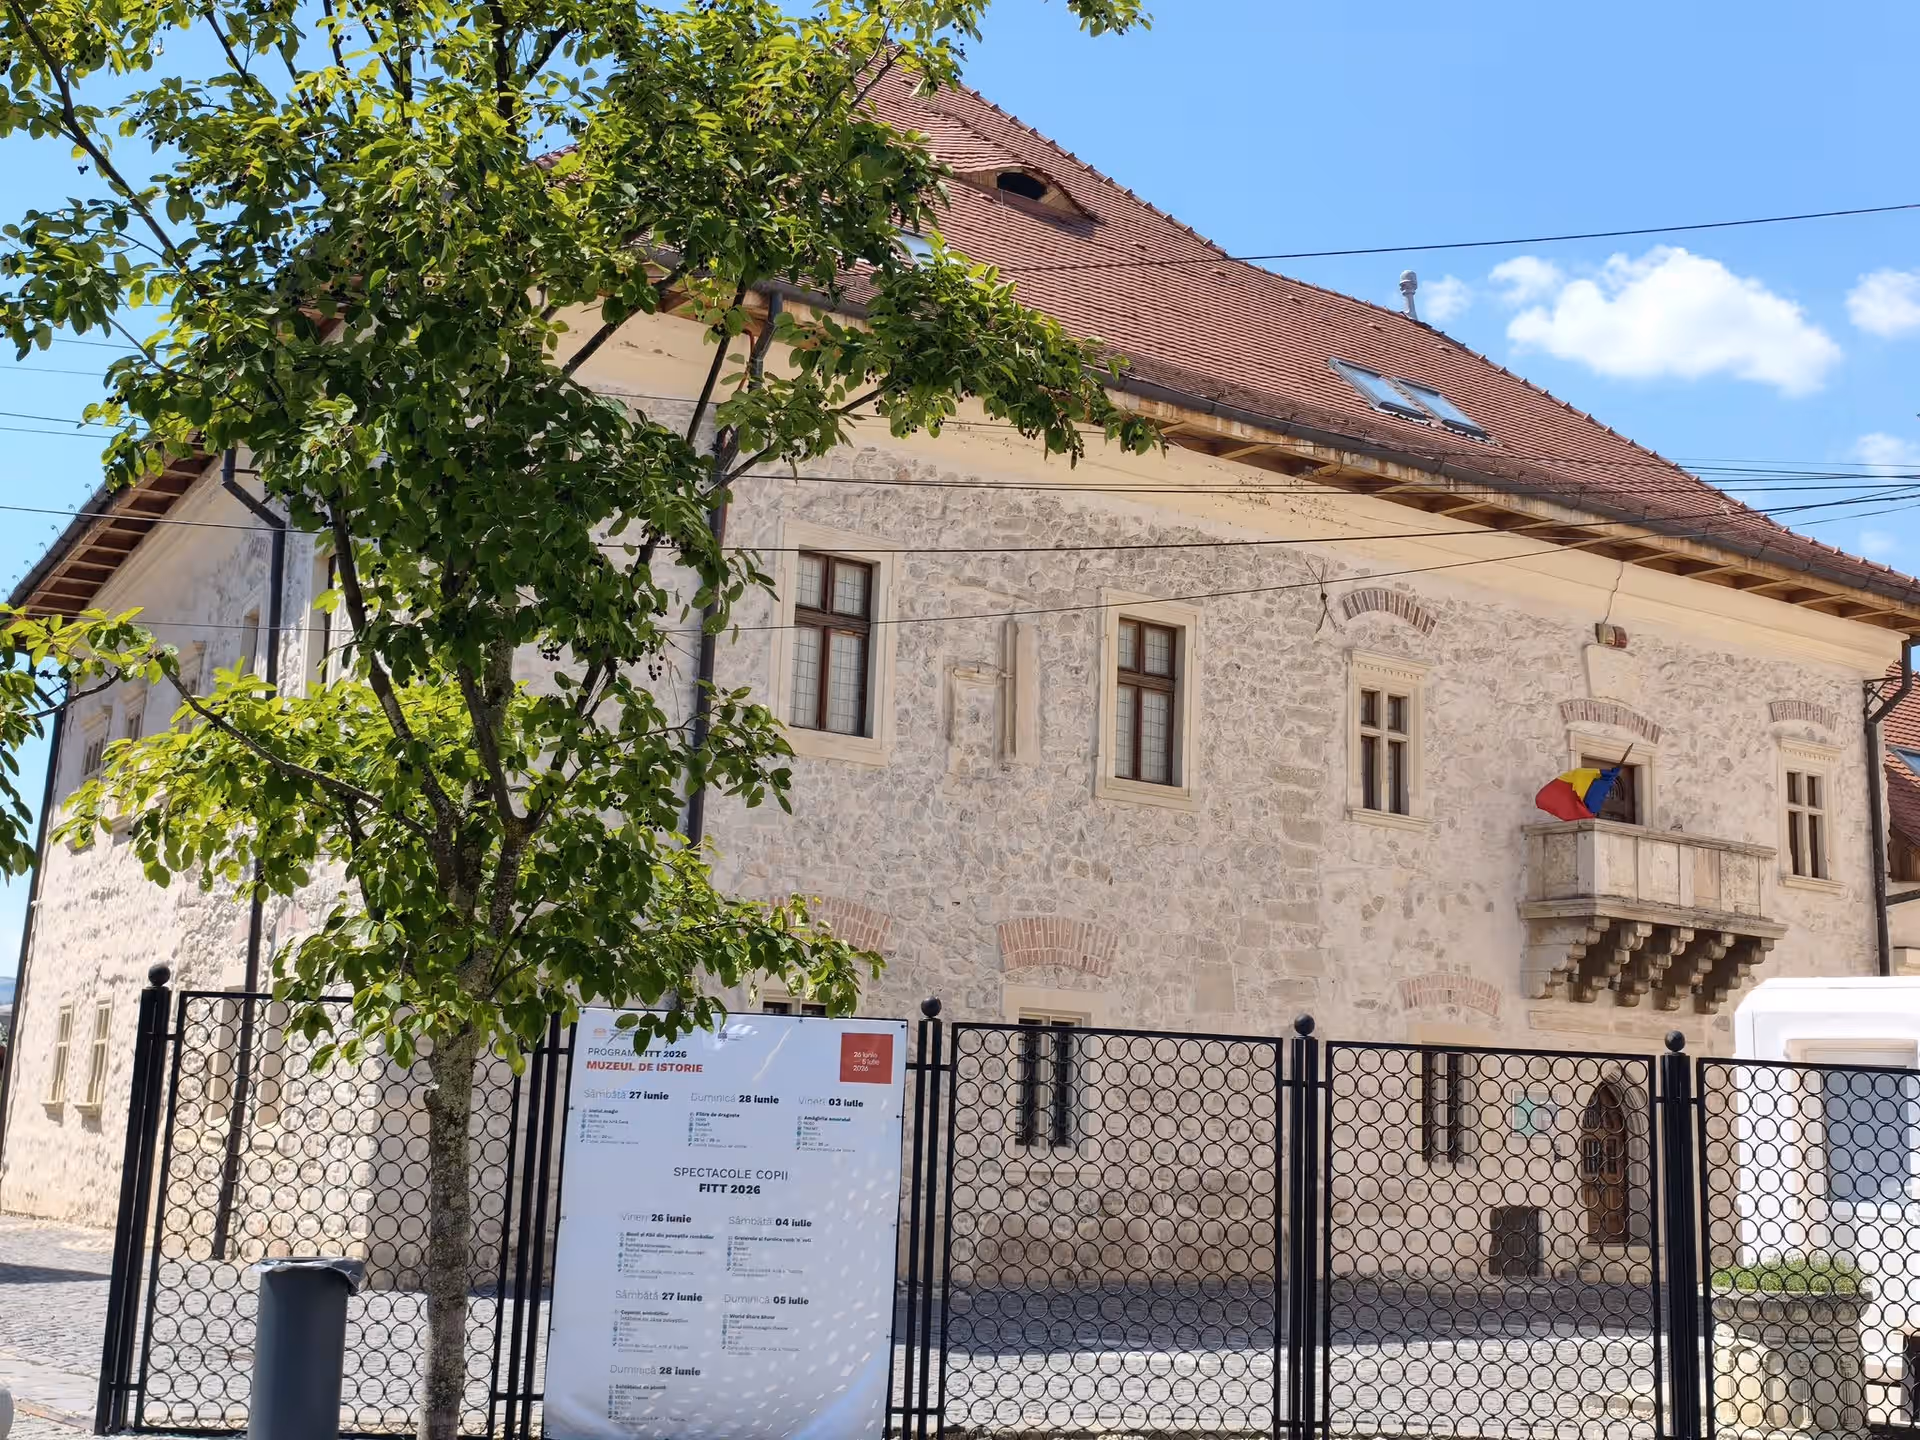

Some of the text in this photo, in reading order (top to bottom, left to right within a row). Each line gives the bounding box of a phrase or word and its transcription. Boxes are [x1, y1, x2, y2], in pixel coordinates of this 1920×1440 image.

[588, 1048, 635, 1057] PROGRAM
[586, 1061, 704, 1073] MUZEUL DE ISTORIE
[629, 1091, 642, 1100] 27
[644, 1091, 670, 1100] iunie
[739, 1094, 752, 1103] 28
[754, 1094, 780, 1104] iunie
[828, 1098, 841, 1106] 03
[844, 1098, 864, 1108] iulie
[674, 1167, 788, 1181] SPECTACOLE COPII
[699, 1183, 760, 1194] FITT 2026
[651, 1213, 664, 1222] 26
[666, 1214, 692, 1223] iunie
[775, 1218, 789, 1226] 04
[791, 1218, 812, 1227] iulie
[661, 1292, 674, 1300] 27
[677, 1292, 703, 1302] iunie
[773, 1296, 786, 1304] 05
[788, 1296, 809, 1305] iulie
[659, 1366, 672, 1375] 28
[675, 1366, 701, 1376] iunie
